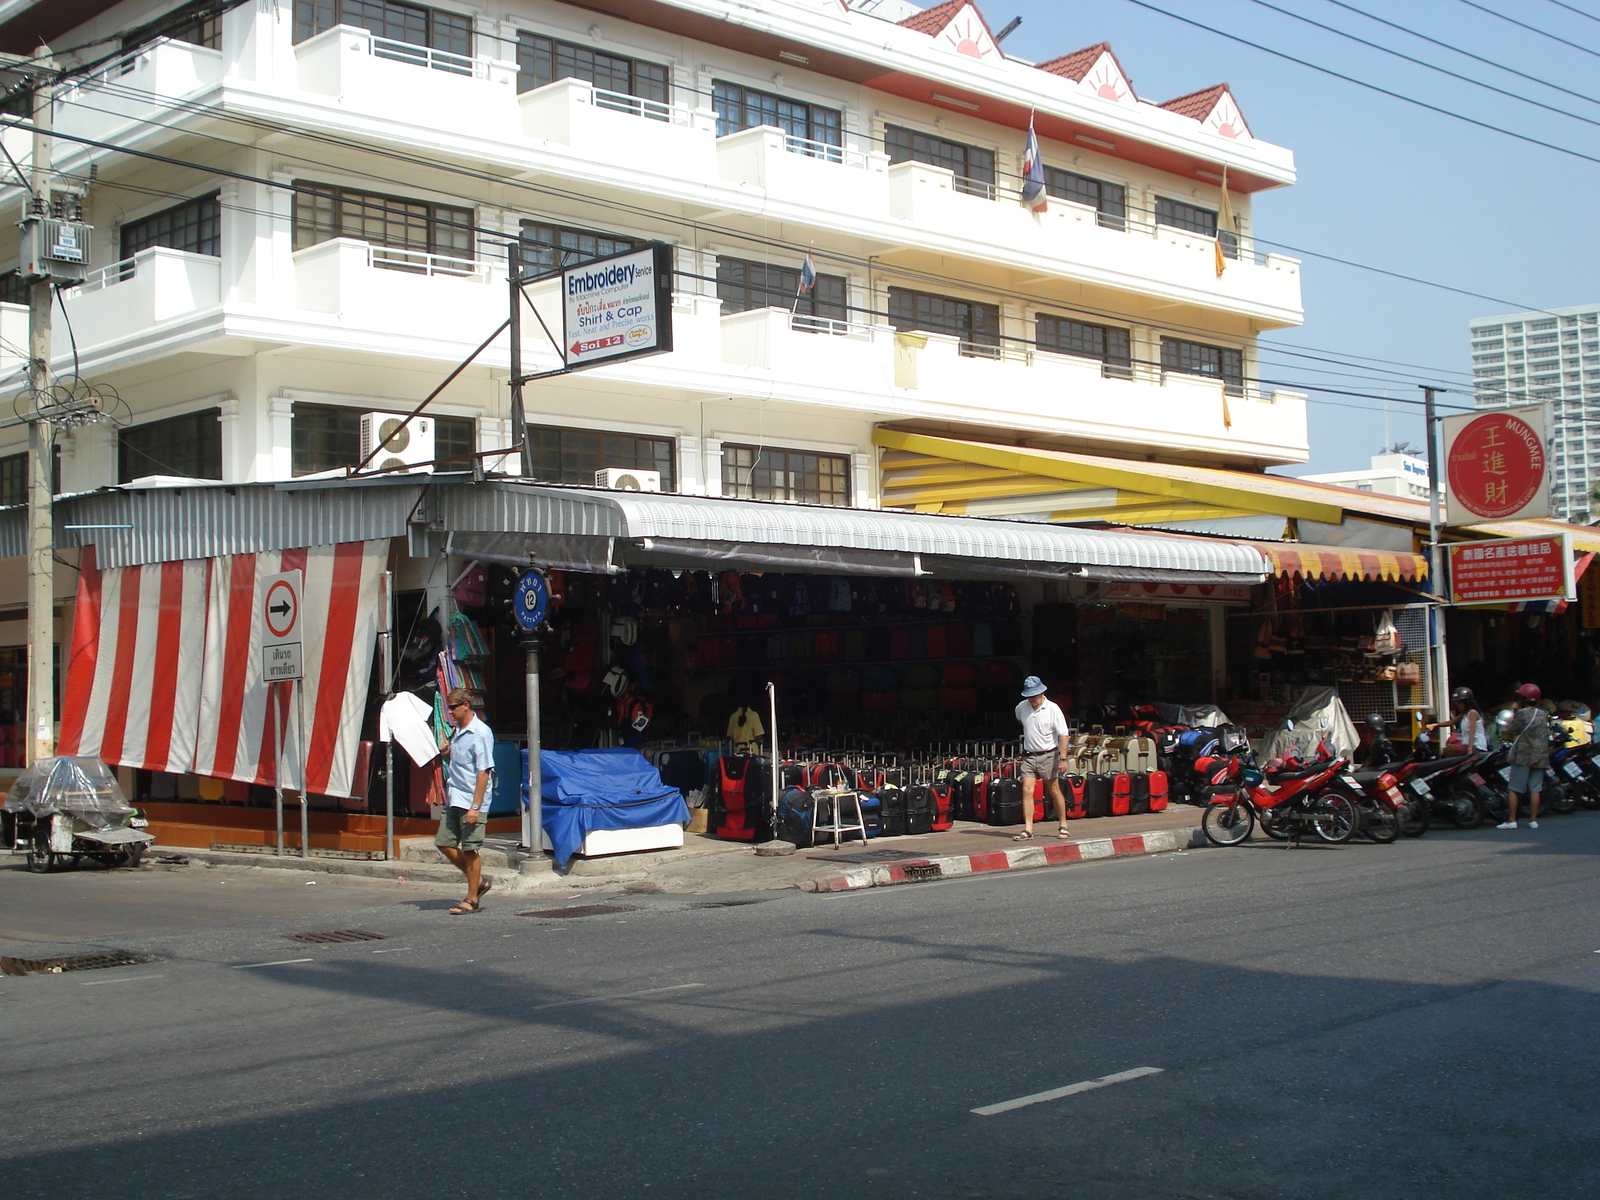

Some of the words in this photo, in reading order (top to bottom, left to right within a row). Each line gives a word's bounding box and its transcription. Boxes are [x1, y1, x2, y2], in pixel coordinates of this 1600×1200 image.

[568, 263, 635, 296] Embroidery
[635, 265, 652, 278] Service
[576, 290, 600, 301] Machine
[601, 284, 629, 295] Computer
[579, 313, 602, 328] Shirt
[606, 310, 614, 321] &
[617, 306, 643, 318] Cap
[583, 326, 597, 336] Neat
[599, 323, 610, 332] and
[612, 318, 634, 329] Precise
[580, 340, 601, 352] Soi
[606, 336, 620, 346] 12
[1505, 418, 1541, 470] MUNGMEE
[1481, 425, 1509, 505] 王進財
[1458, 486, 1536, 517] www.mungmeesnack.com
[526, 594, 534, 605] 12
[521, 611, 541, 623] PATTAYA
